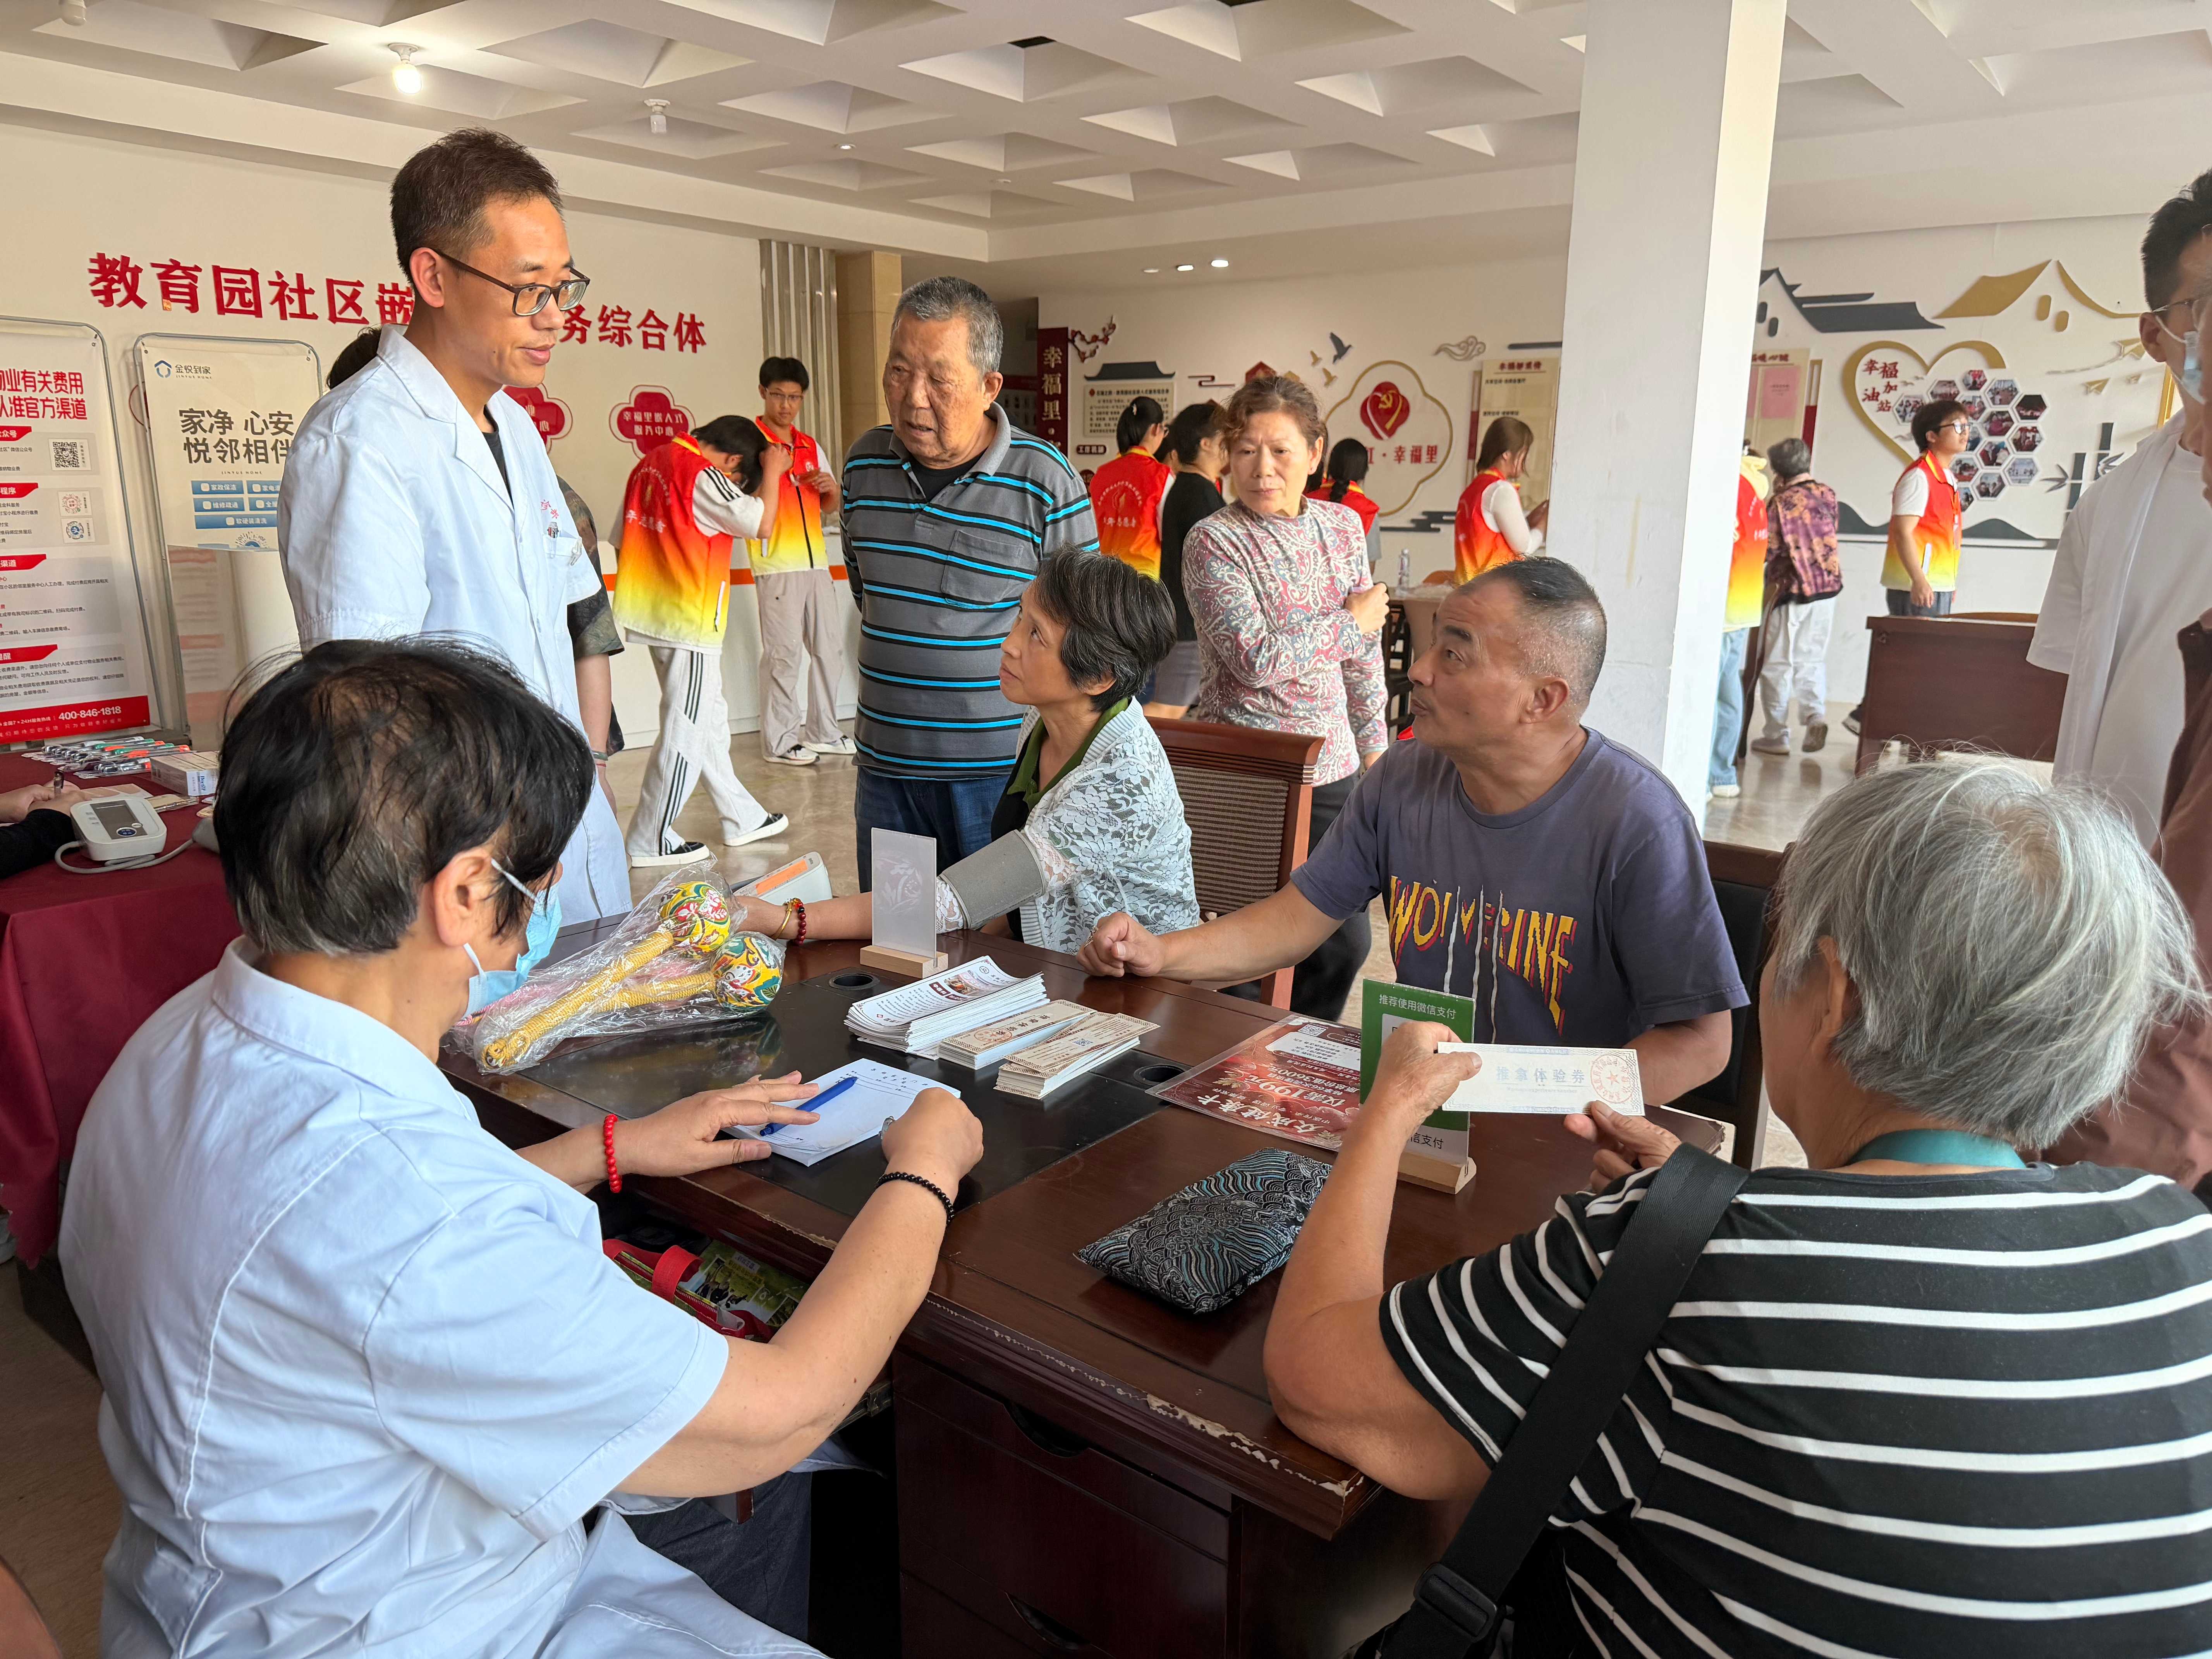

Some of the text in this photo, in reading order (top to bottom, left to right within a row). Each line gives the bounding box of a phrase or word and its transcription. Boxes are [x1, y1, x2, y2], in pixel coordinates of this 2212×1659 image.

[175, 364, 211, 374] 金悦到家
[179, 407, 294, 436] 家净 心安
[623, 411, 684, 424] 幸福里嵌入式
[0, 430, 17, 438] 众号
[634, 425, 674, 436] 服务中心
[58, 706, 122, 720] 400-846-1818
[1379, 994, 1457, 1020] 推荐使用微信支付
[1496, 1066, 1585, 1084] 推拿体验券
[1245, 1073, 1346, 1107] 仅需199元
[1197, 1094, 1327, 1133] 众成健康卡
